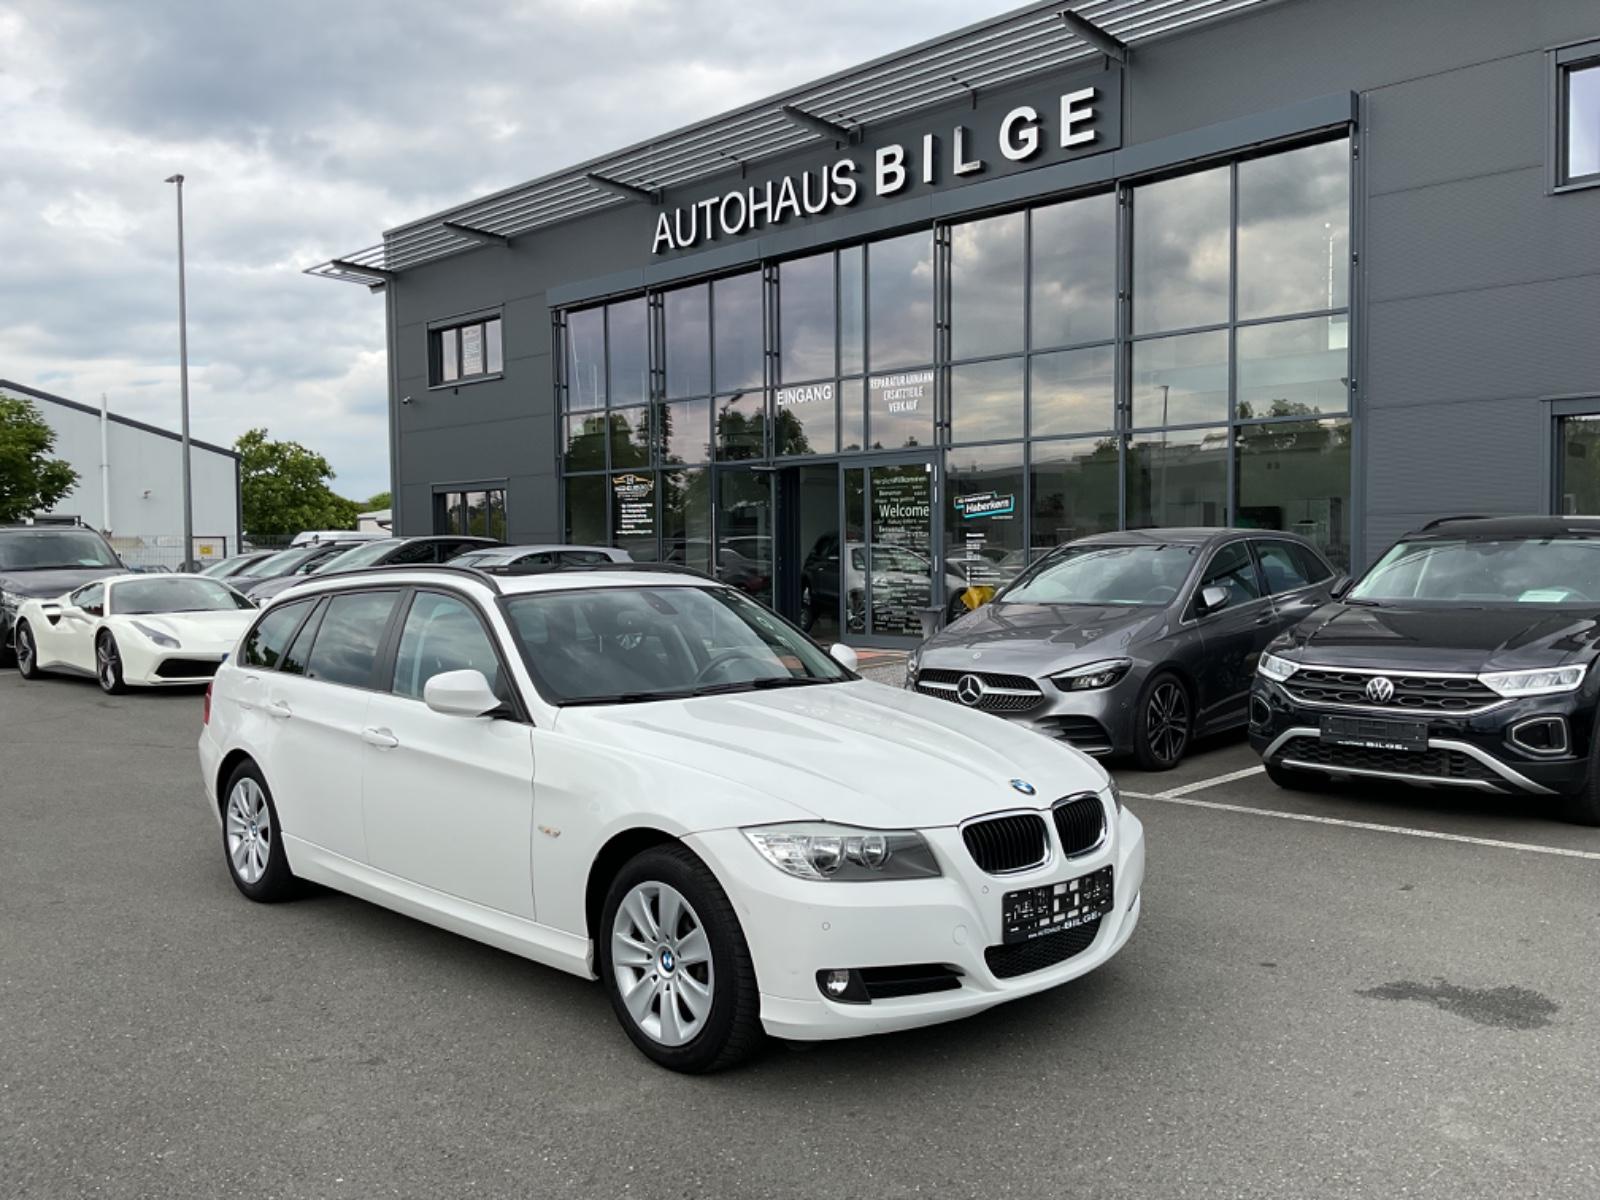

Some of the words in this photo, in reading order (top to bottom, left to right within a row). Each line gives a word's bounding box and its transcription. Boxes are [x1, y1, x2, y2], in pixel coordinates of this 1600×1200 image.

[651, 159, 857, 254] AUTOHAUS
[875, 86, 1097, 196] BILGE
[776, 384, 833, 406] EINGANG
[878, 503, 930, 517] Welcome
